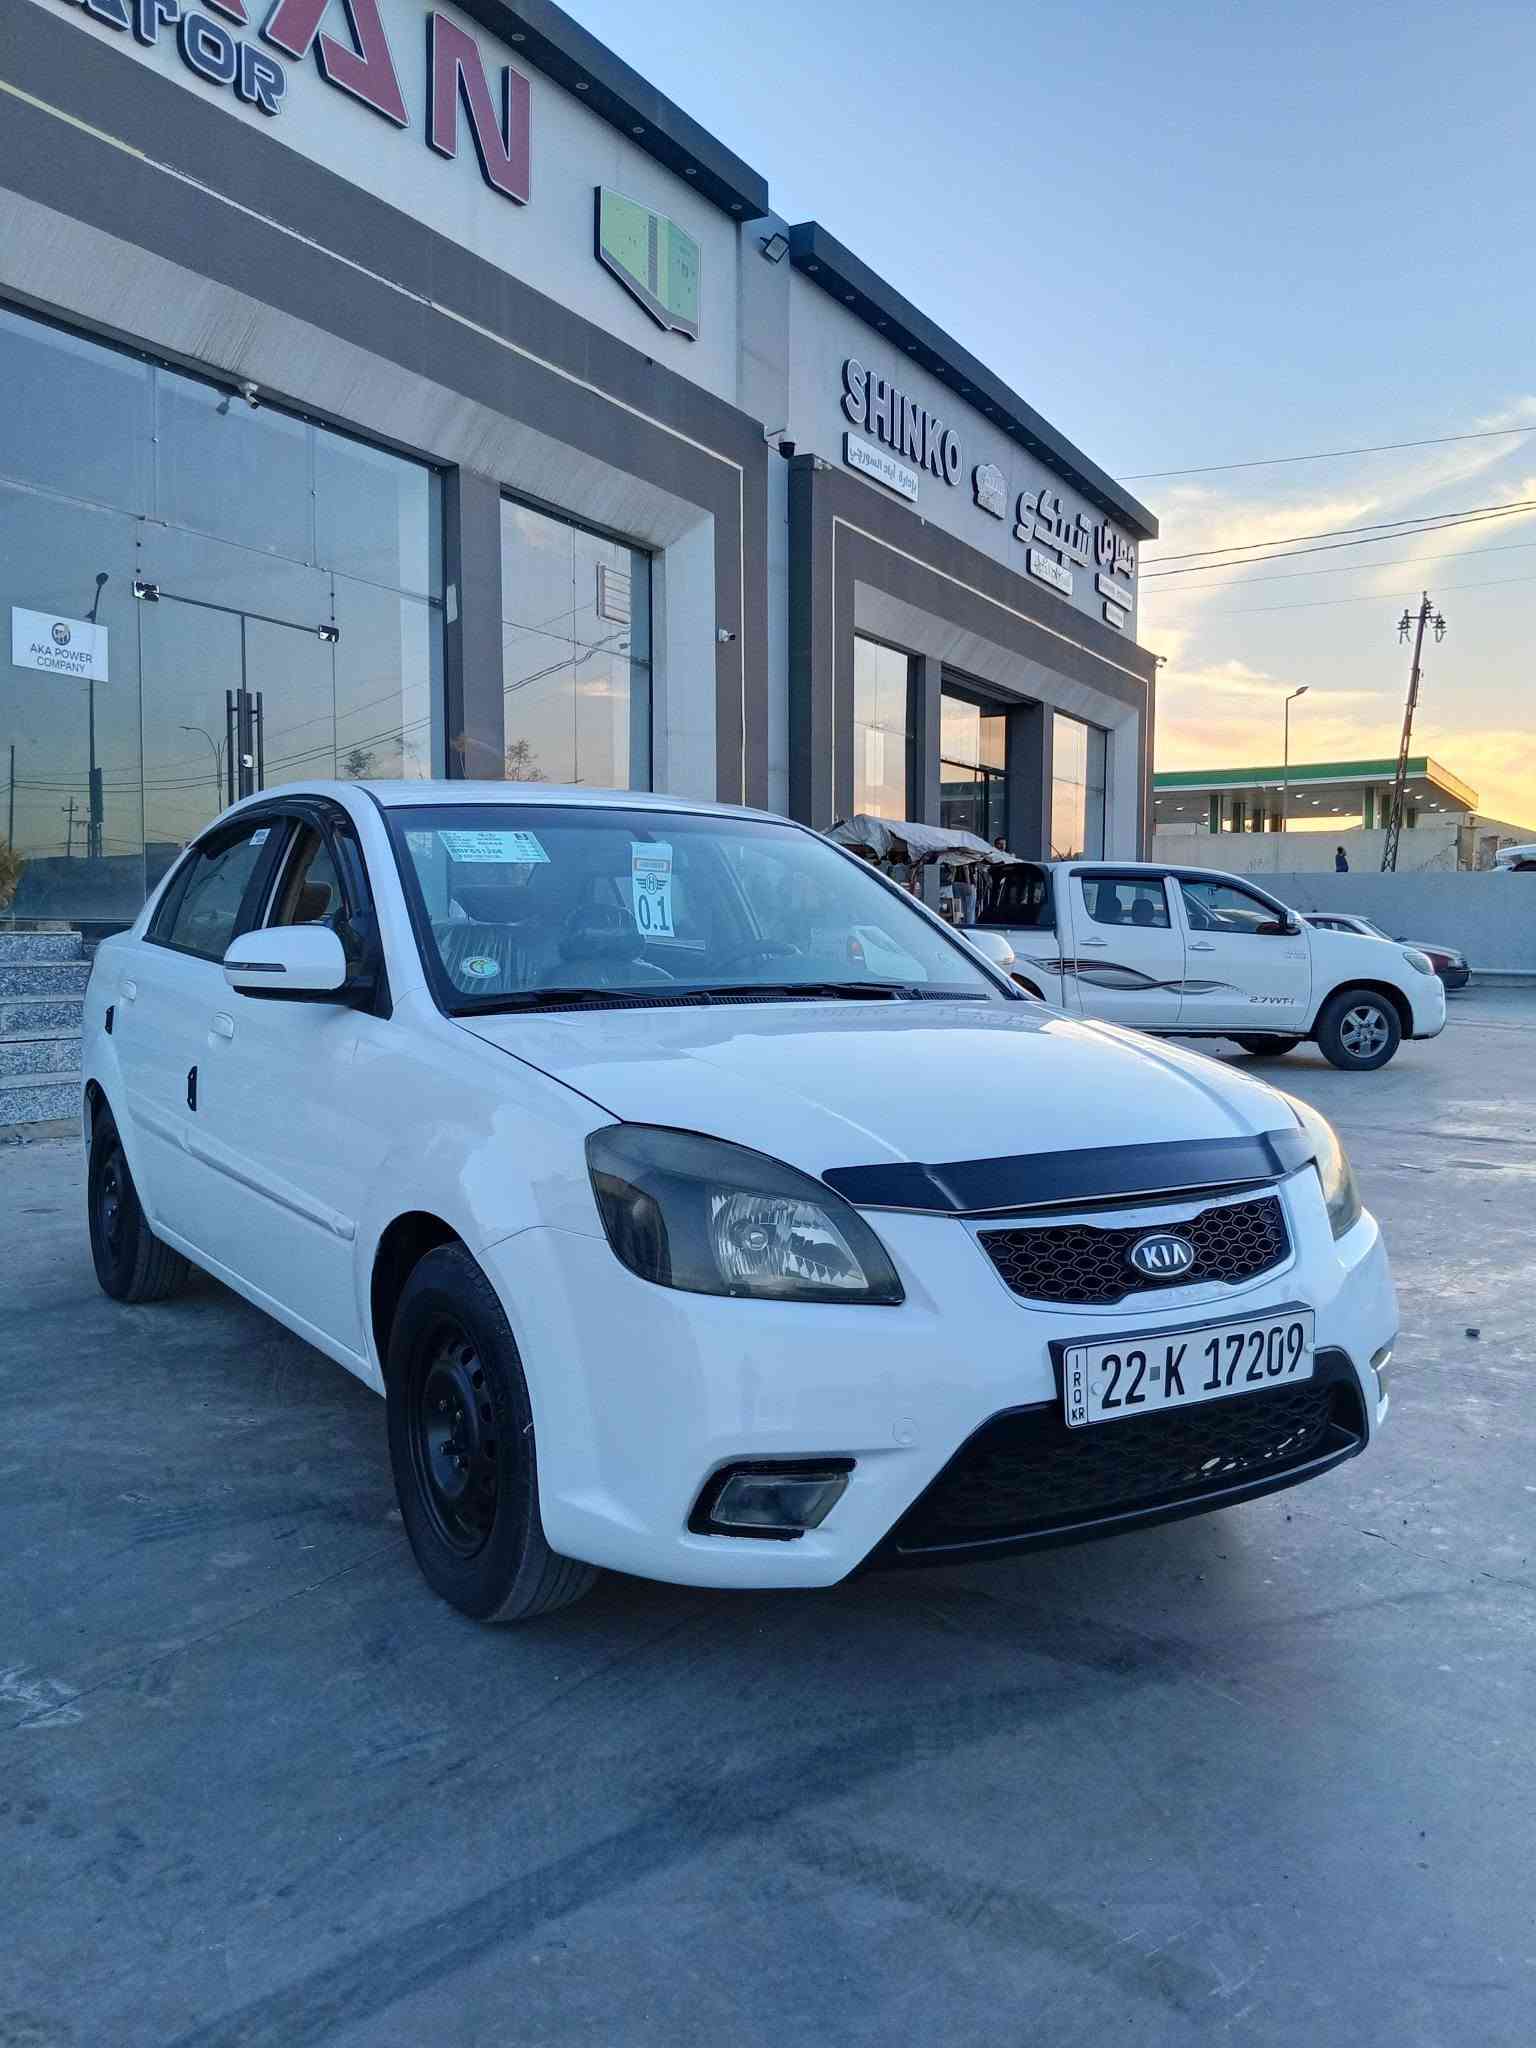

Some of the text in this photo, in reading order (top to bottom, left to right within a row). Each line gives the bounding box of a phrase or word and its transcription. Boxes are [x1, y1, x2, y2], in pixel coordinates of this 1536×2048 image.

[199, 0, 532, 206] AN
[845, 358, 963, 486] SHINKO
[30, 642, 93, 664] AKA POWER
[37, 656, 86, 673] COMPANY
[639, 894, 671, 931] 0.1
[1142, 1243, 1188, 1269] KIA
[1101, 1322, 1305, 1409] 22 K 17209
[1071, 1406, 1085, 1420] KR
